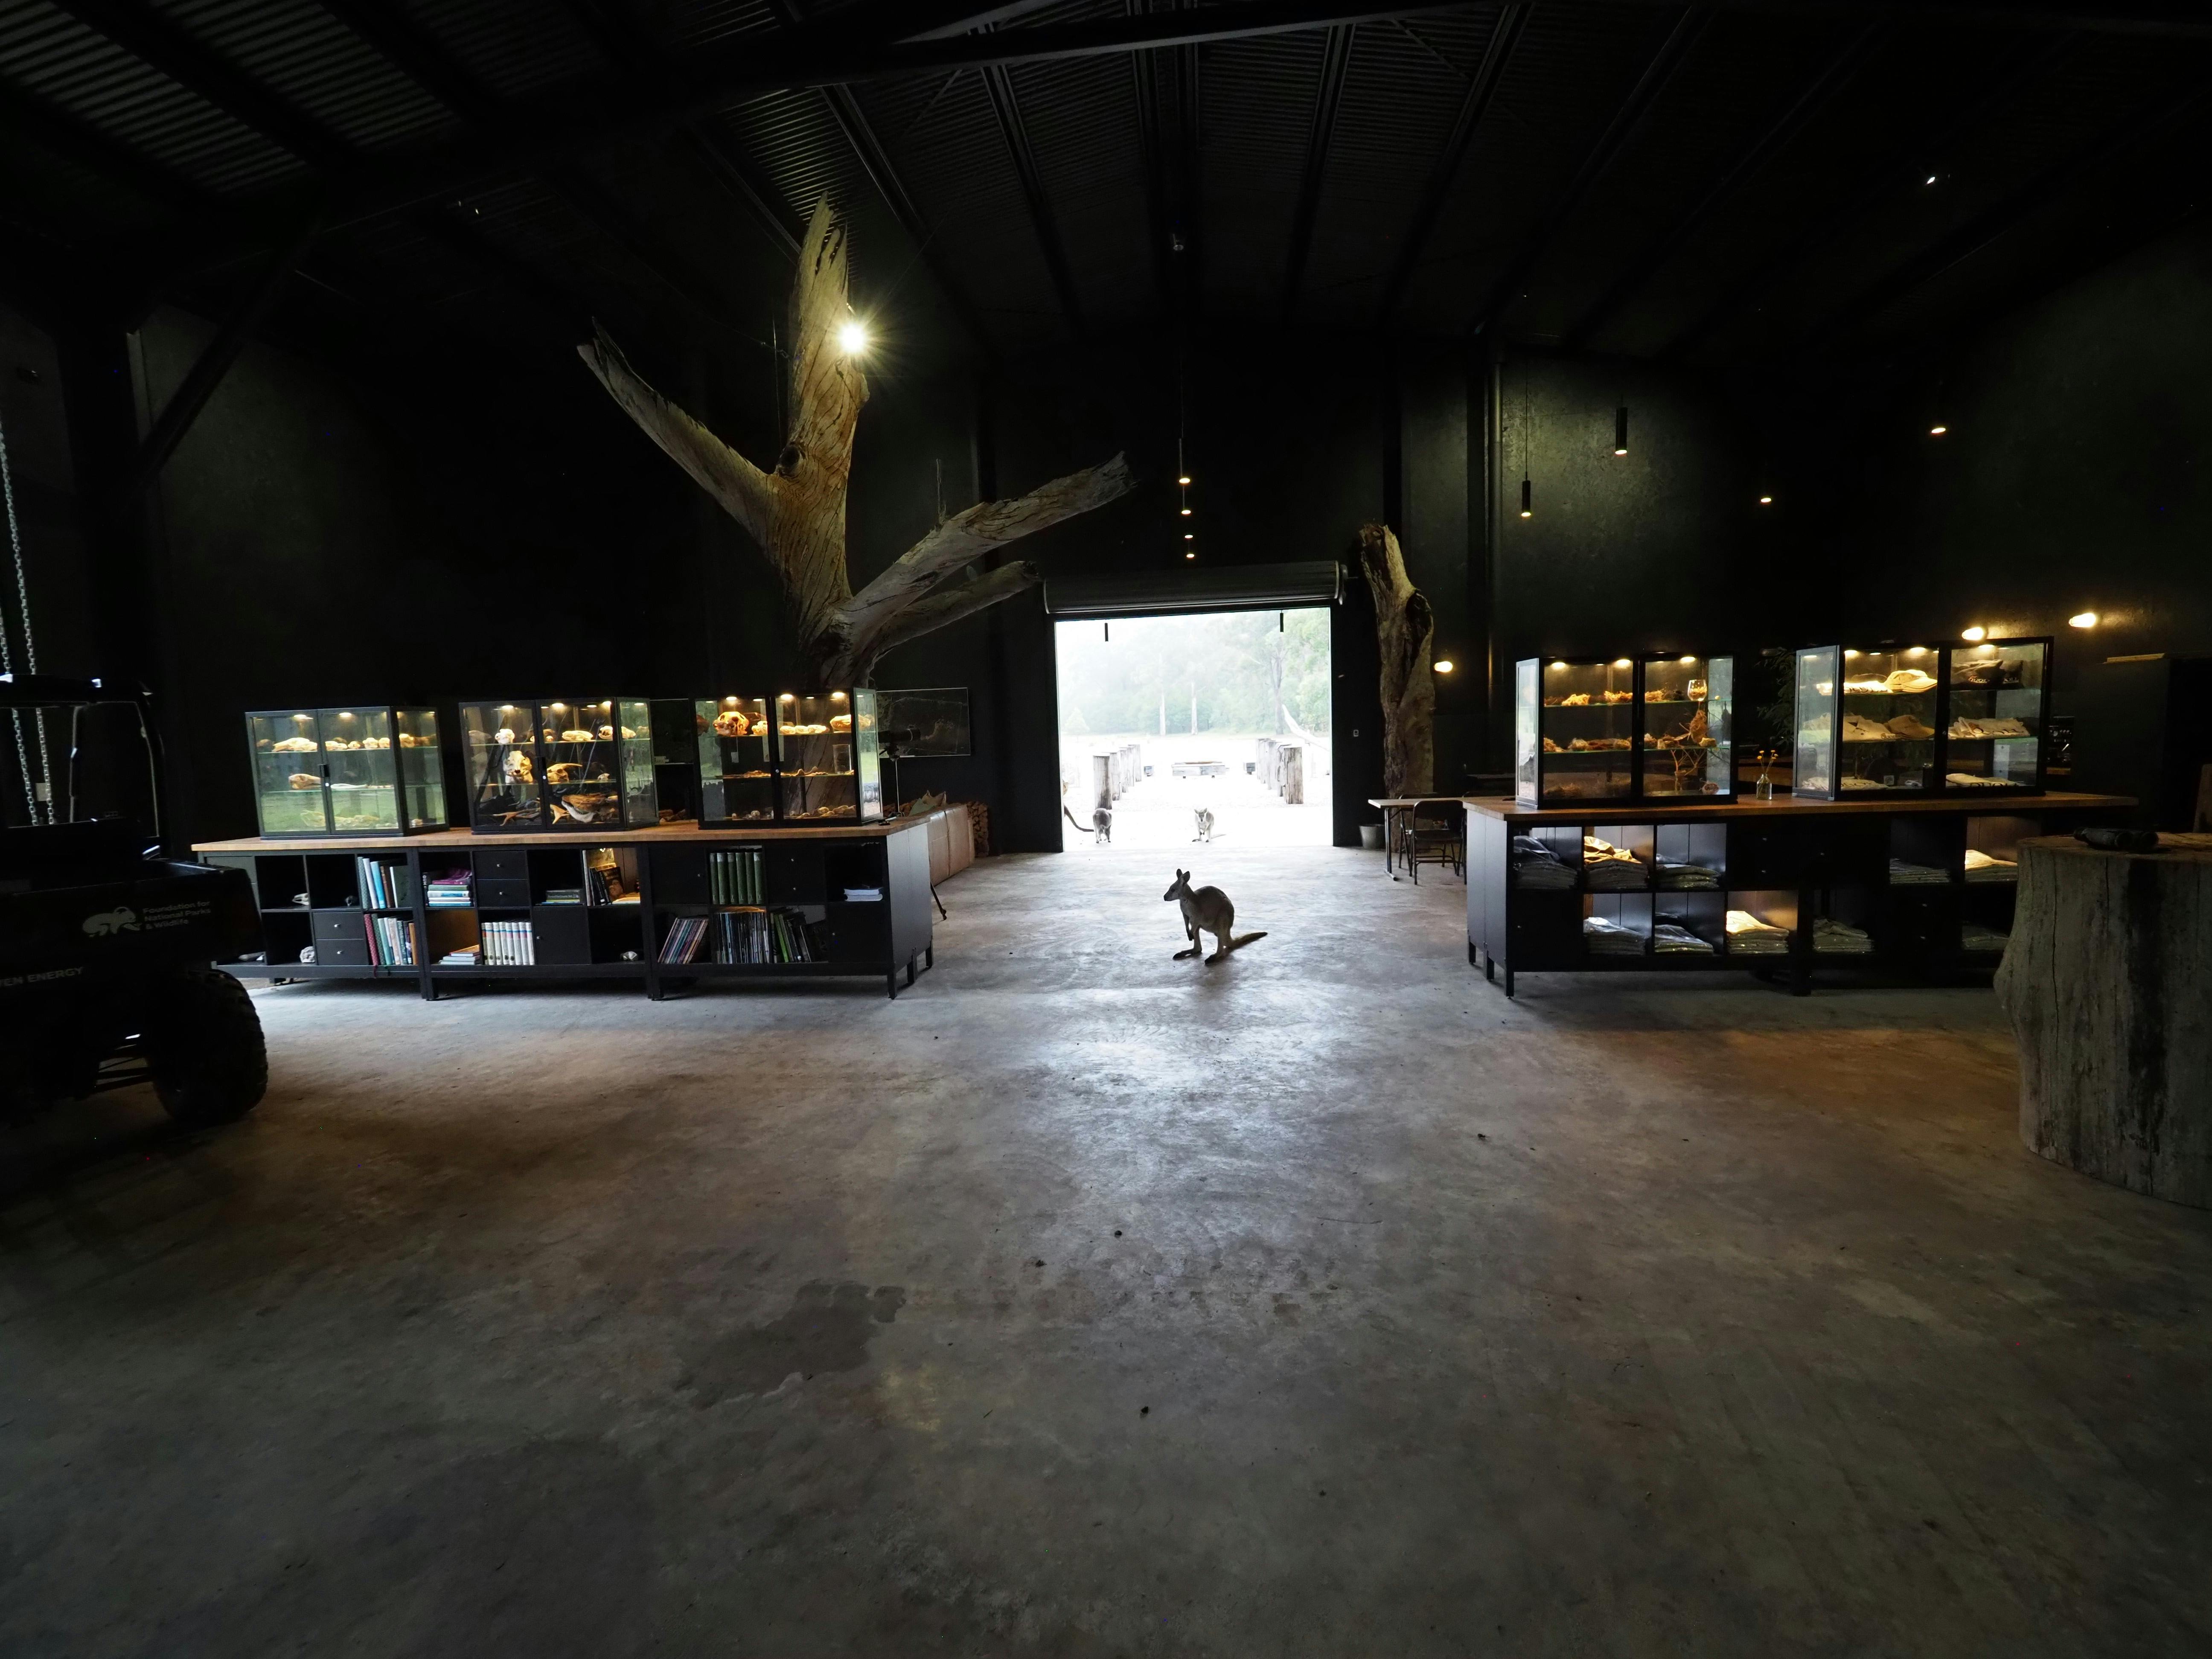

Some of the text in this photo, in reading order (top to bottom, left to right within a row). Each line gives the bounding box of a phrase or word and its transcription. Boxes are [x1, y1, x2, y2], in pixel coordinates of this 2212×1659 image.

[143, 903, 196, 914] Foundation
[144, 911, 184, 922] National
[154, 919, 189, 928] Wildlife
[27, 966, 84, 984] ENERGY
